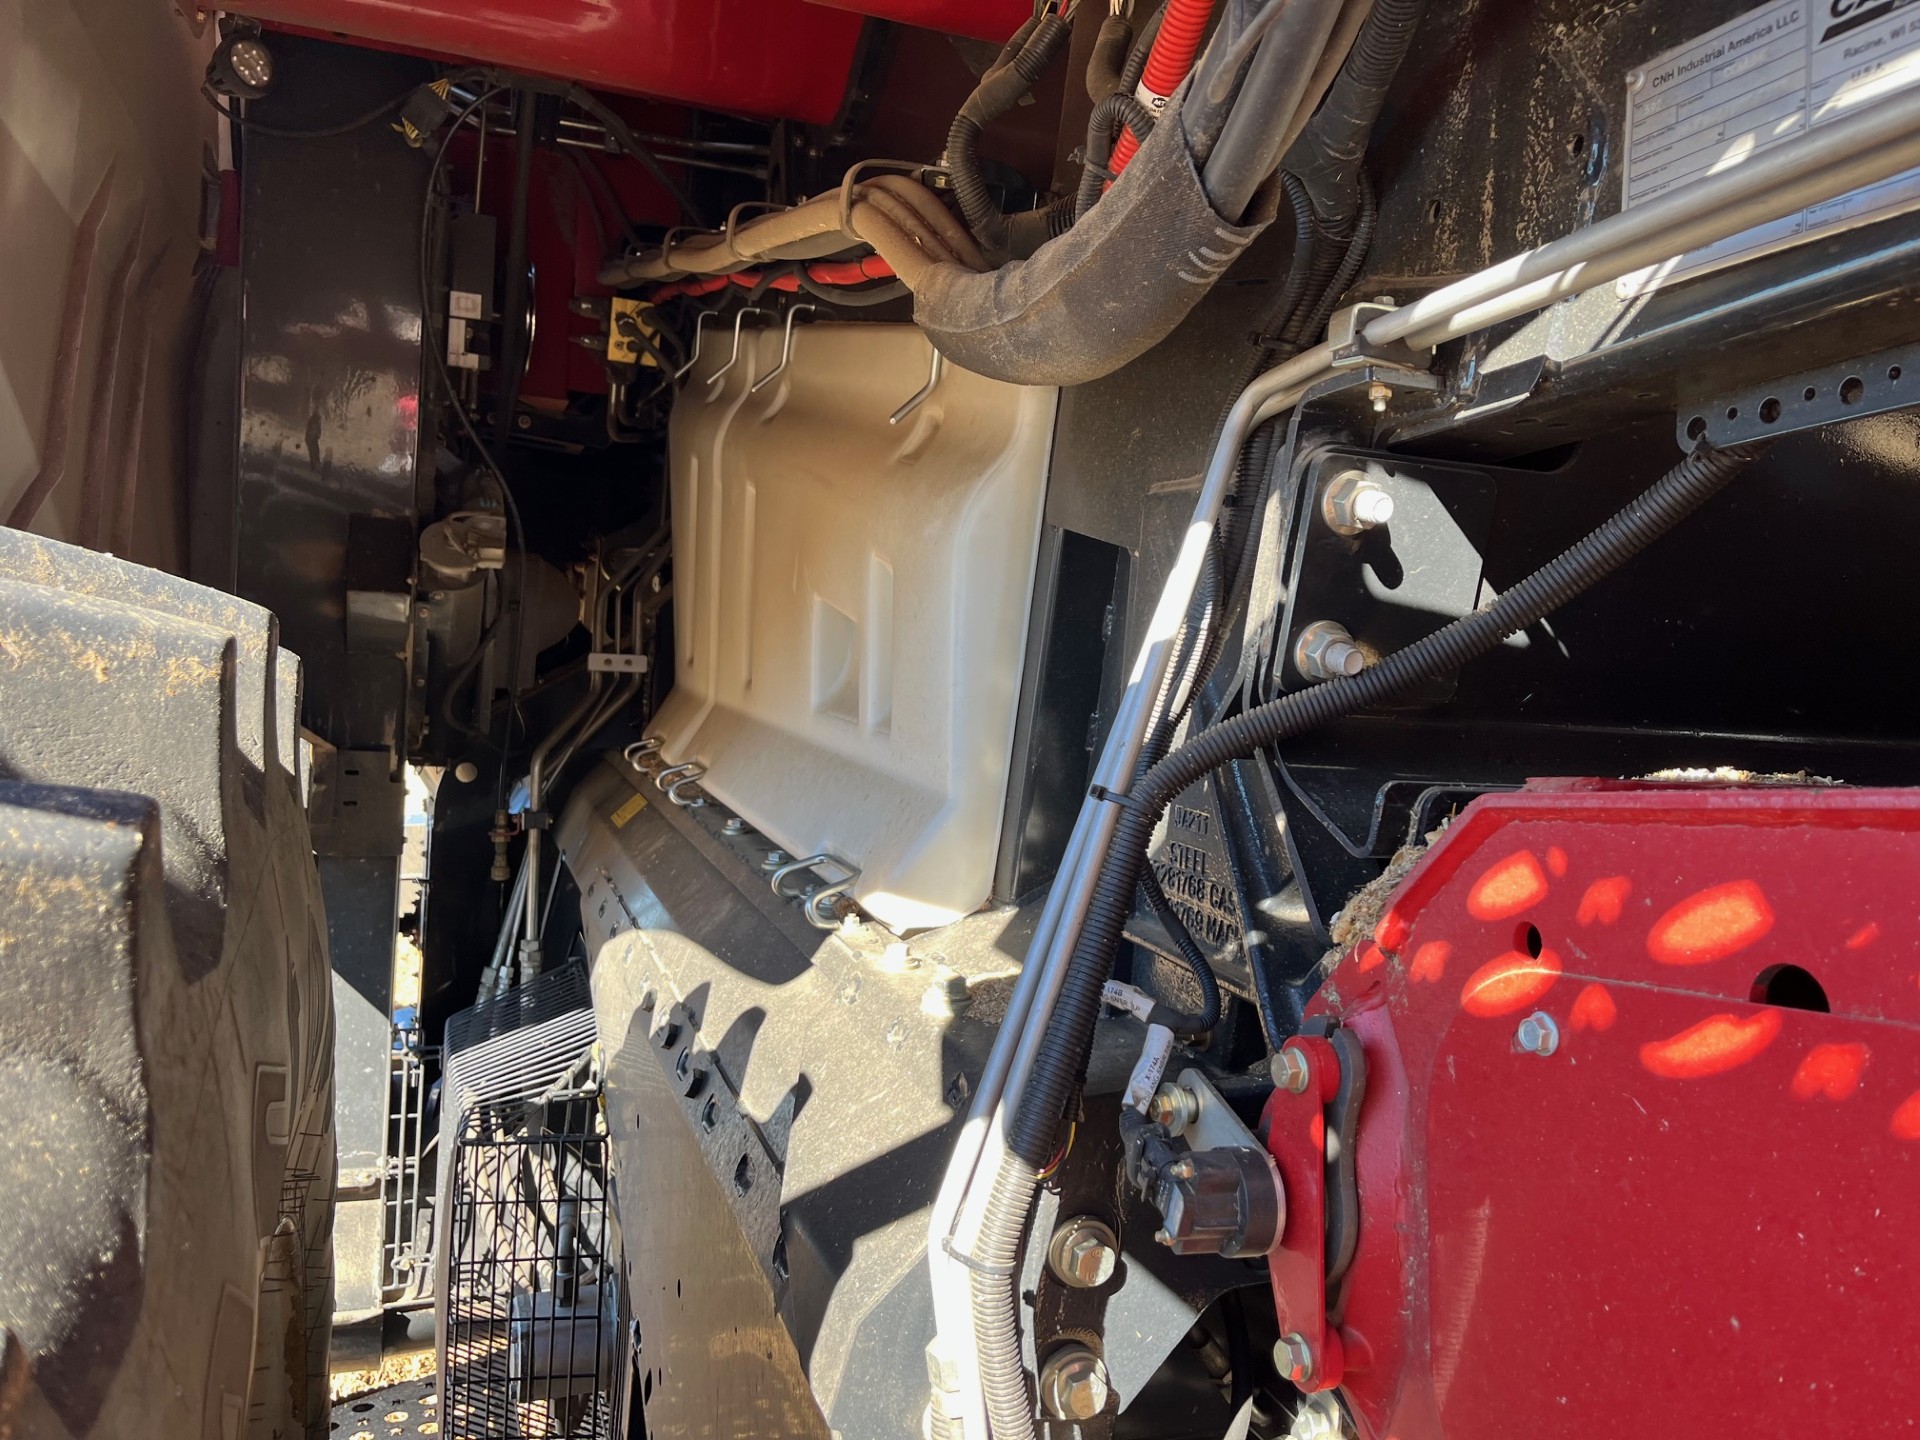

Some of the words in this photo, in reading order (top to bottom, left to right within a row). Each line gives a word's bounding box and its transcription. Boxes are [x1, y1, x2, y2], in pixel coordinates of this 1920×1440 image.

[1652, 69, 1675, 88] CNH
[1677, 45, 1725, 77] Industrial
[1727, 24, 1773, 53] America
[1775, 9, 1800, 31] LLC
[1169, 841, 1208, 878] STEEL
[1144, 1056, 1160, 1081] X-174A
[1149, 1075, 1159, 1091] ANG
